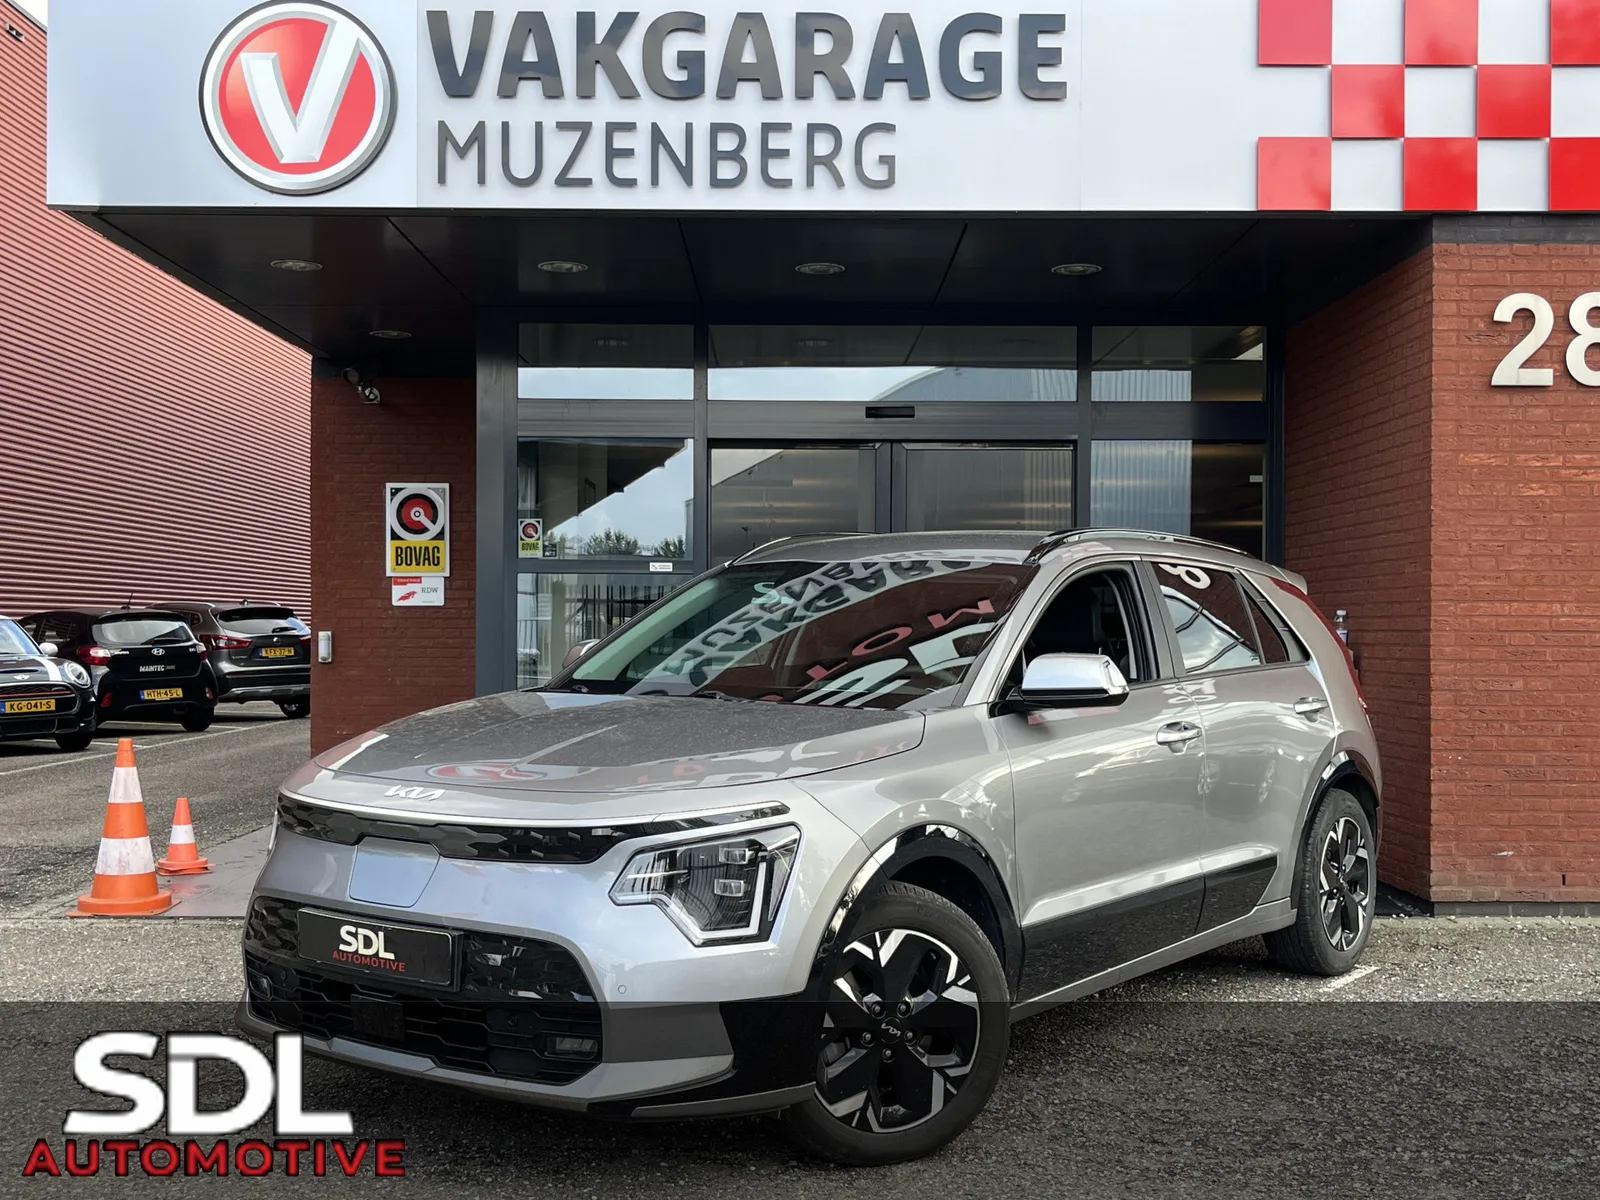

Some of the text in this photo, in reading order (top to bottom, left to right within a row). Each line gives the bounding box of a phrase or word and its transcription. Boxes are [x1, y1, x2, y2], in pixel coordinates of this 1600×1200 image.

[425, 10, 1067, 100] VAKGARAGE
[437, 120, 896, 188] MUZENBERG
[1490, 291, 1600, 387] 28
[394, 545, 441, 567] BOVAG
[521, 542, 540, 551] BOVAG
[421, 586, 439, 594] RDW
[139, 664, 165, 673] MAINTEC
[9, 700, 52, 711] KG-041-S
[384, 784, 446, 801] KIA
[338, 925, 395, 960] SDL
[332, 950, 406, 972] AUTOMOTIVE
